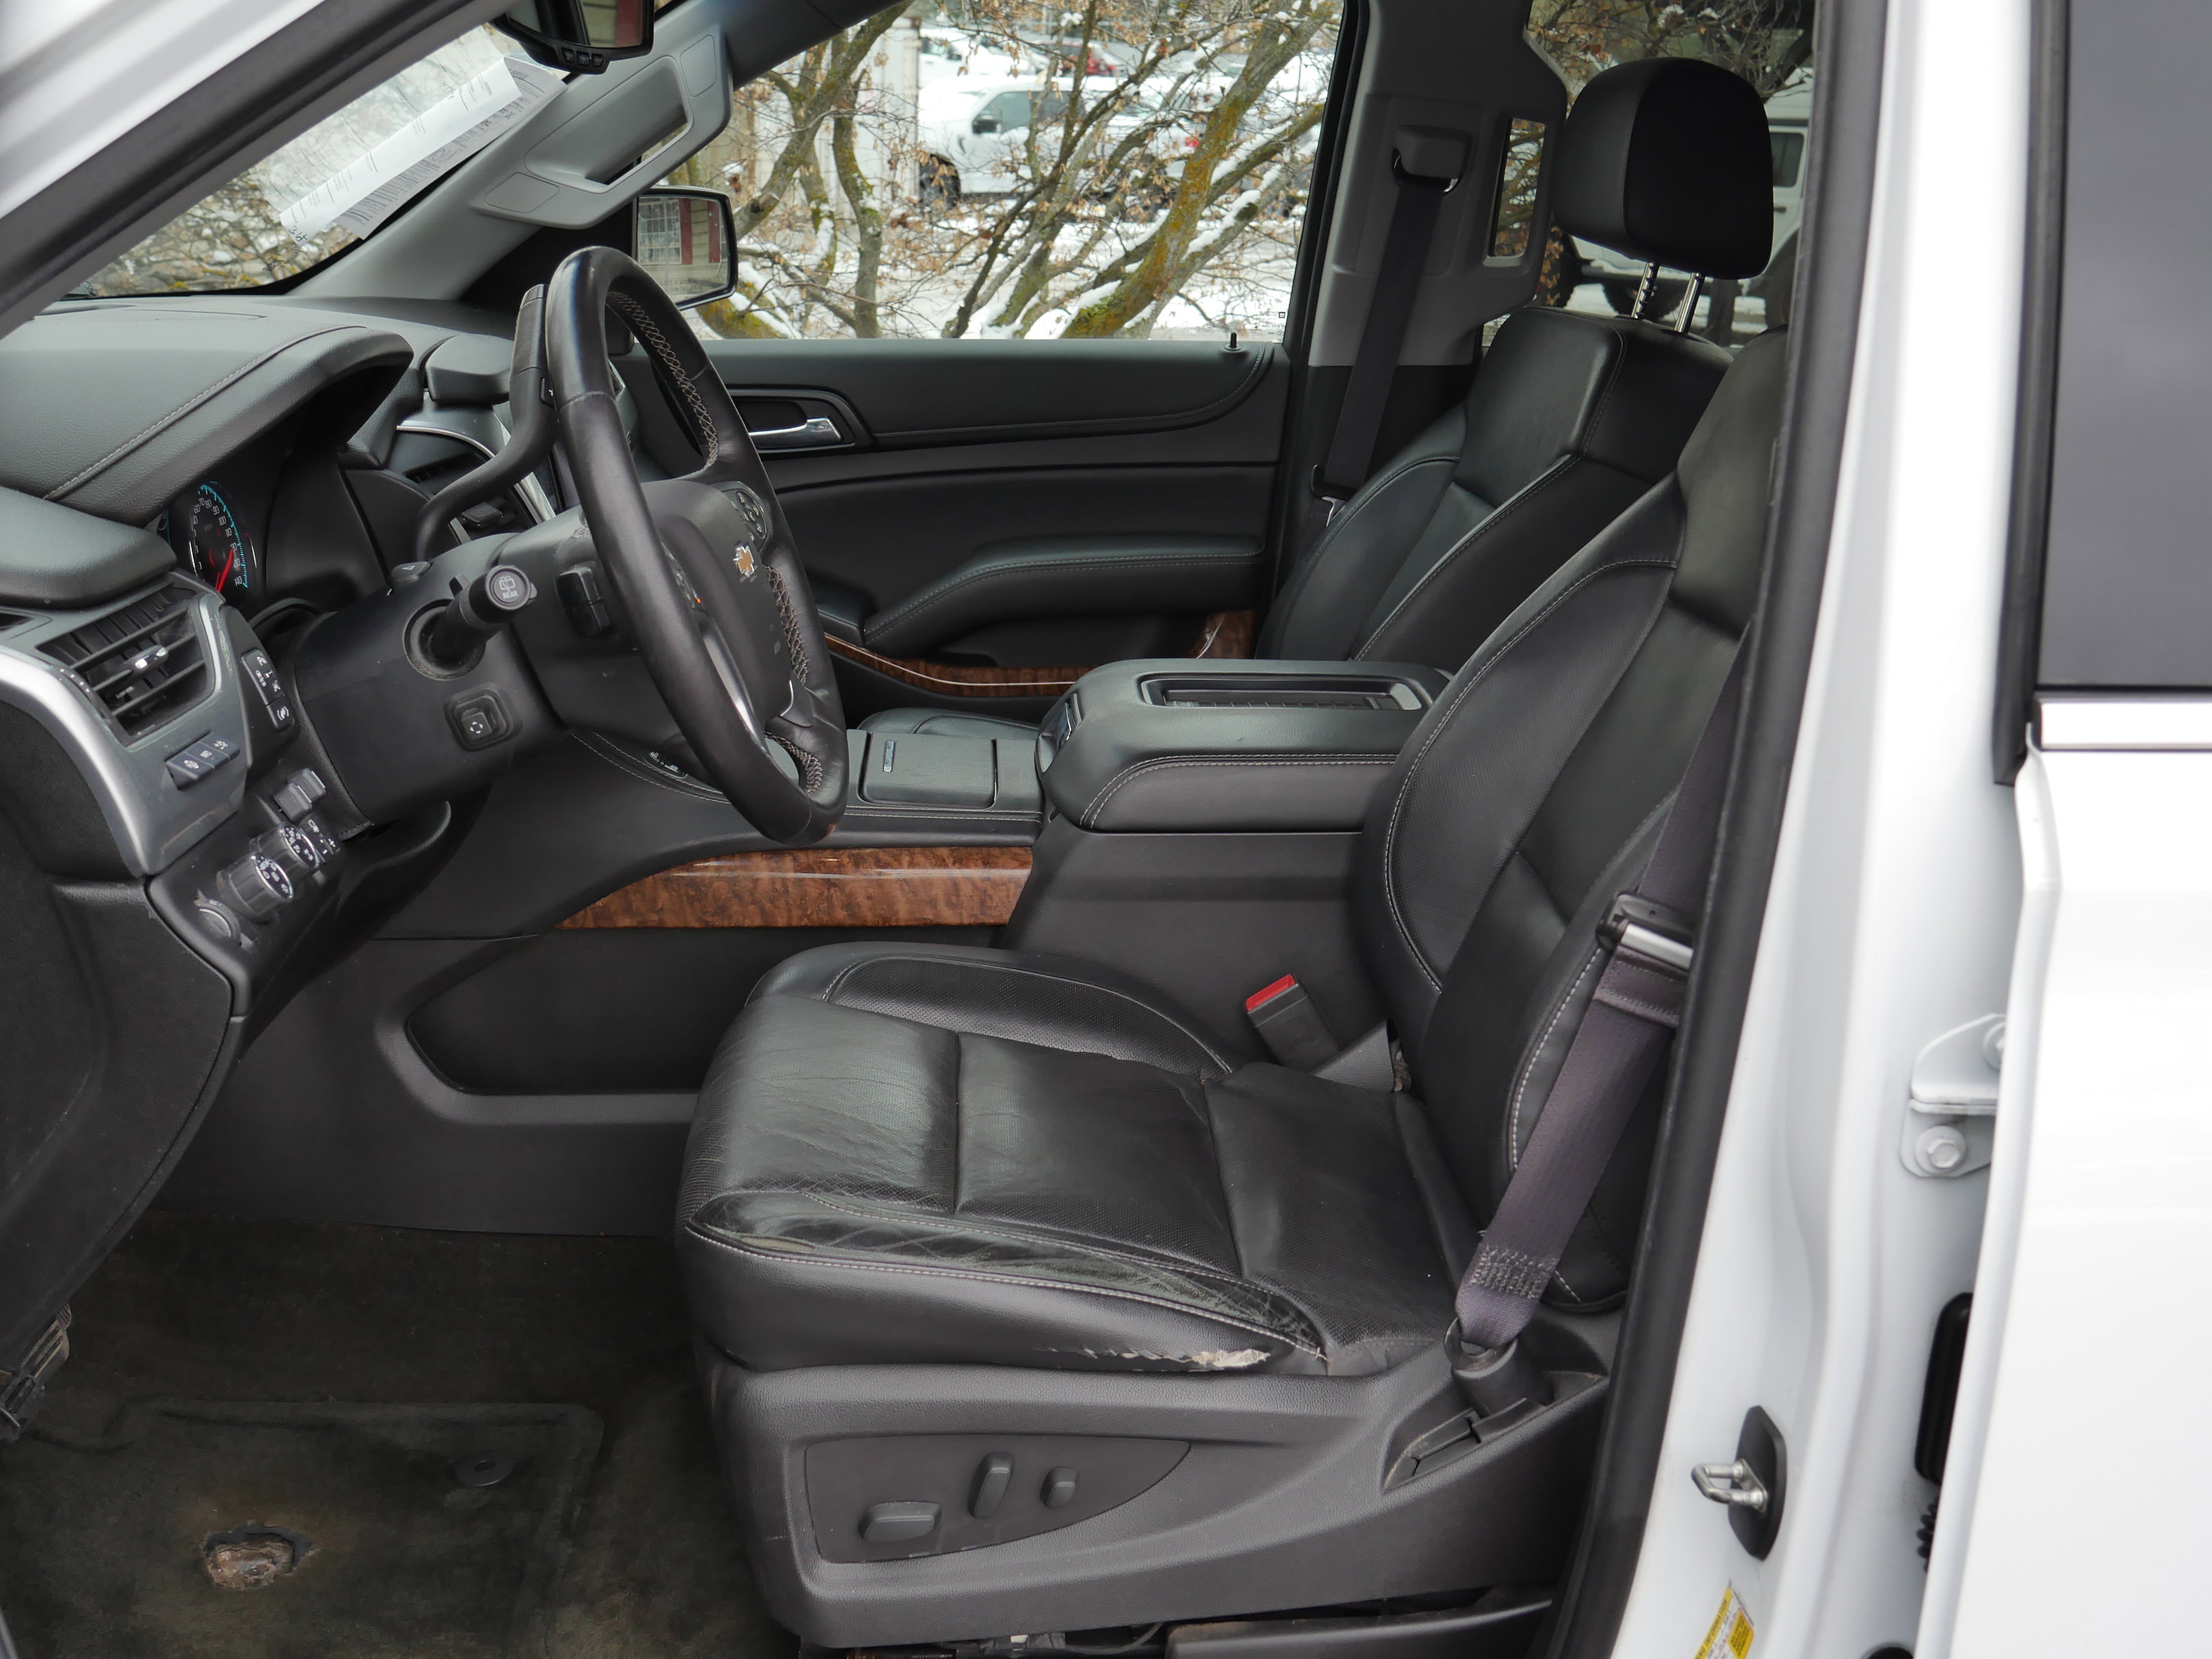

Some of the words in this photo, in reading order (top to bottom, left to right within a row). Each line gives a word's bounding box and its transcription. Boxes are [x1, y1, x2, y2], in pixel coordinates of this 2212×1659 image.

[198, 497, 205, 507] 70
[205, 499, 212, 509] 80
[212, 505, 220, 515] 90
[218, 515, 227, 526] 100
[234, 576, 242, 587] 140
[502, 590, 519, 600] REAR
[1704, 1598, 1728, 1648] INFORMATION
